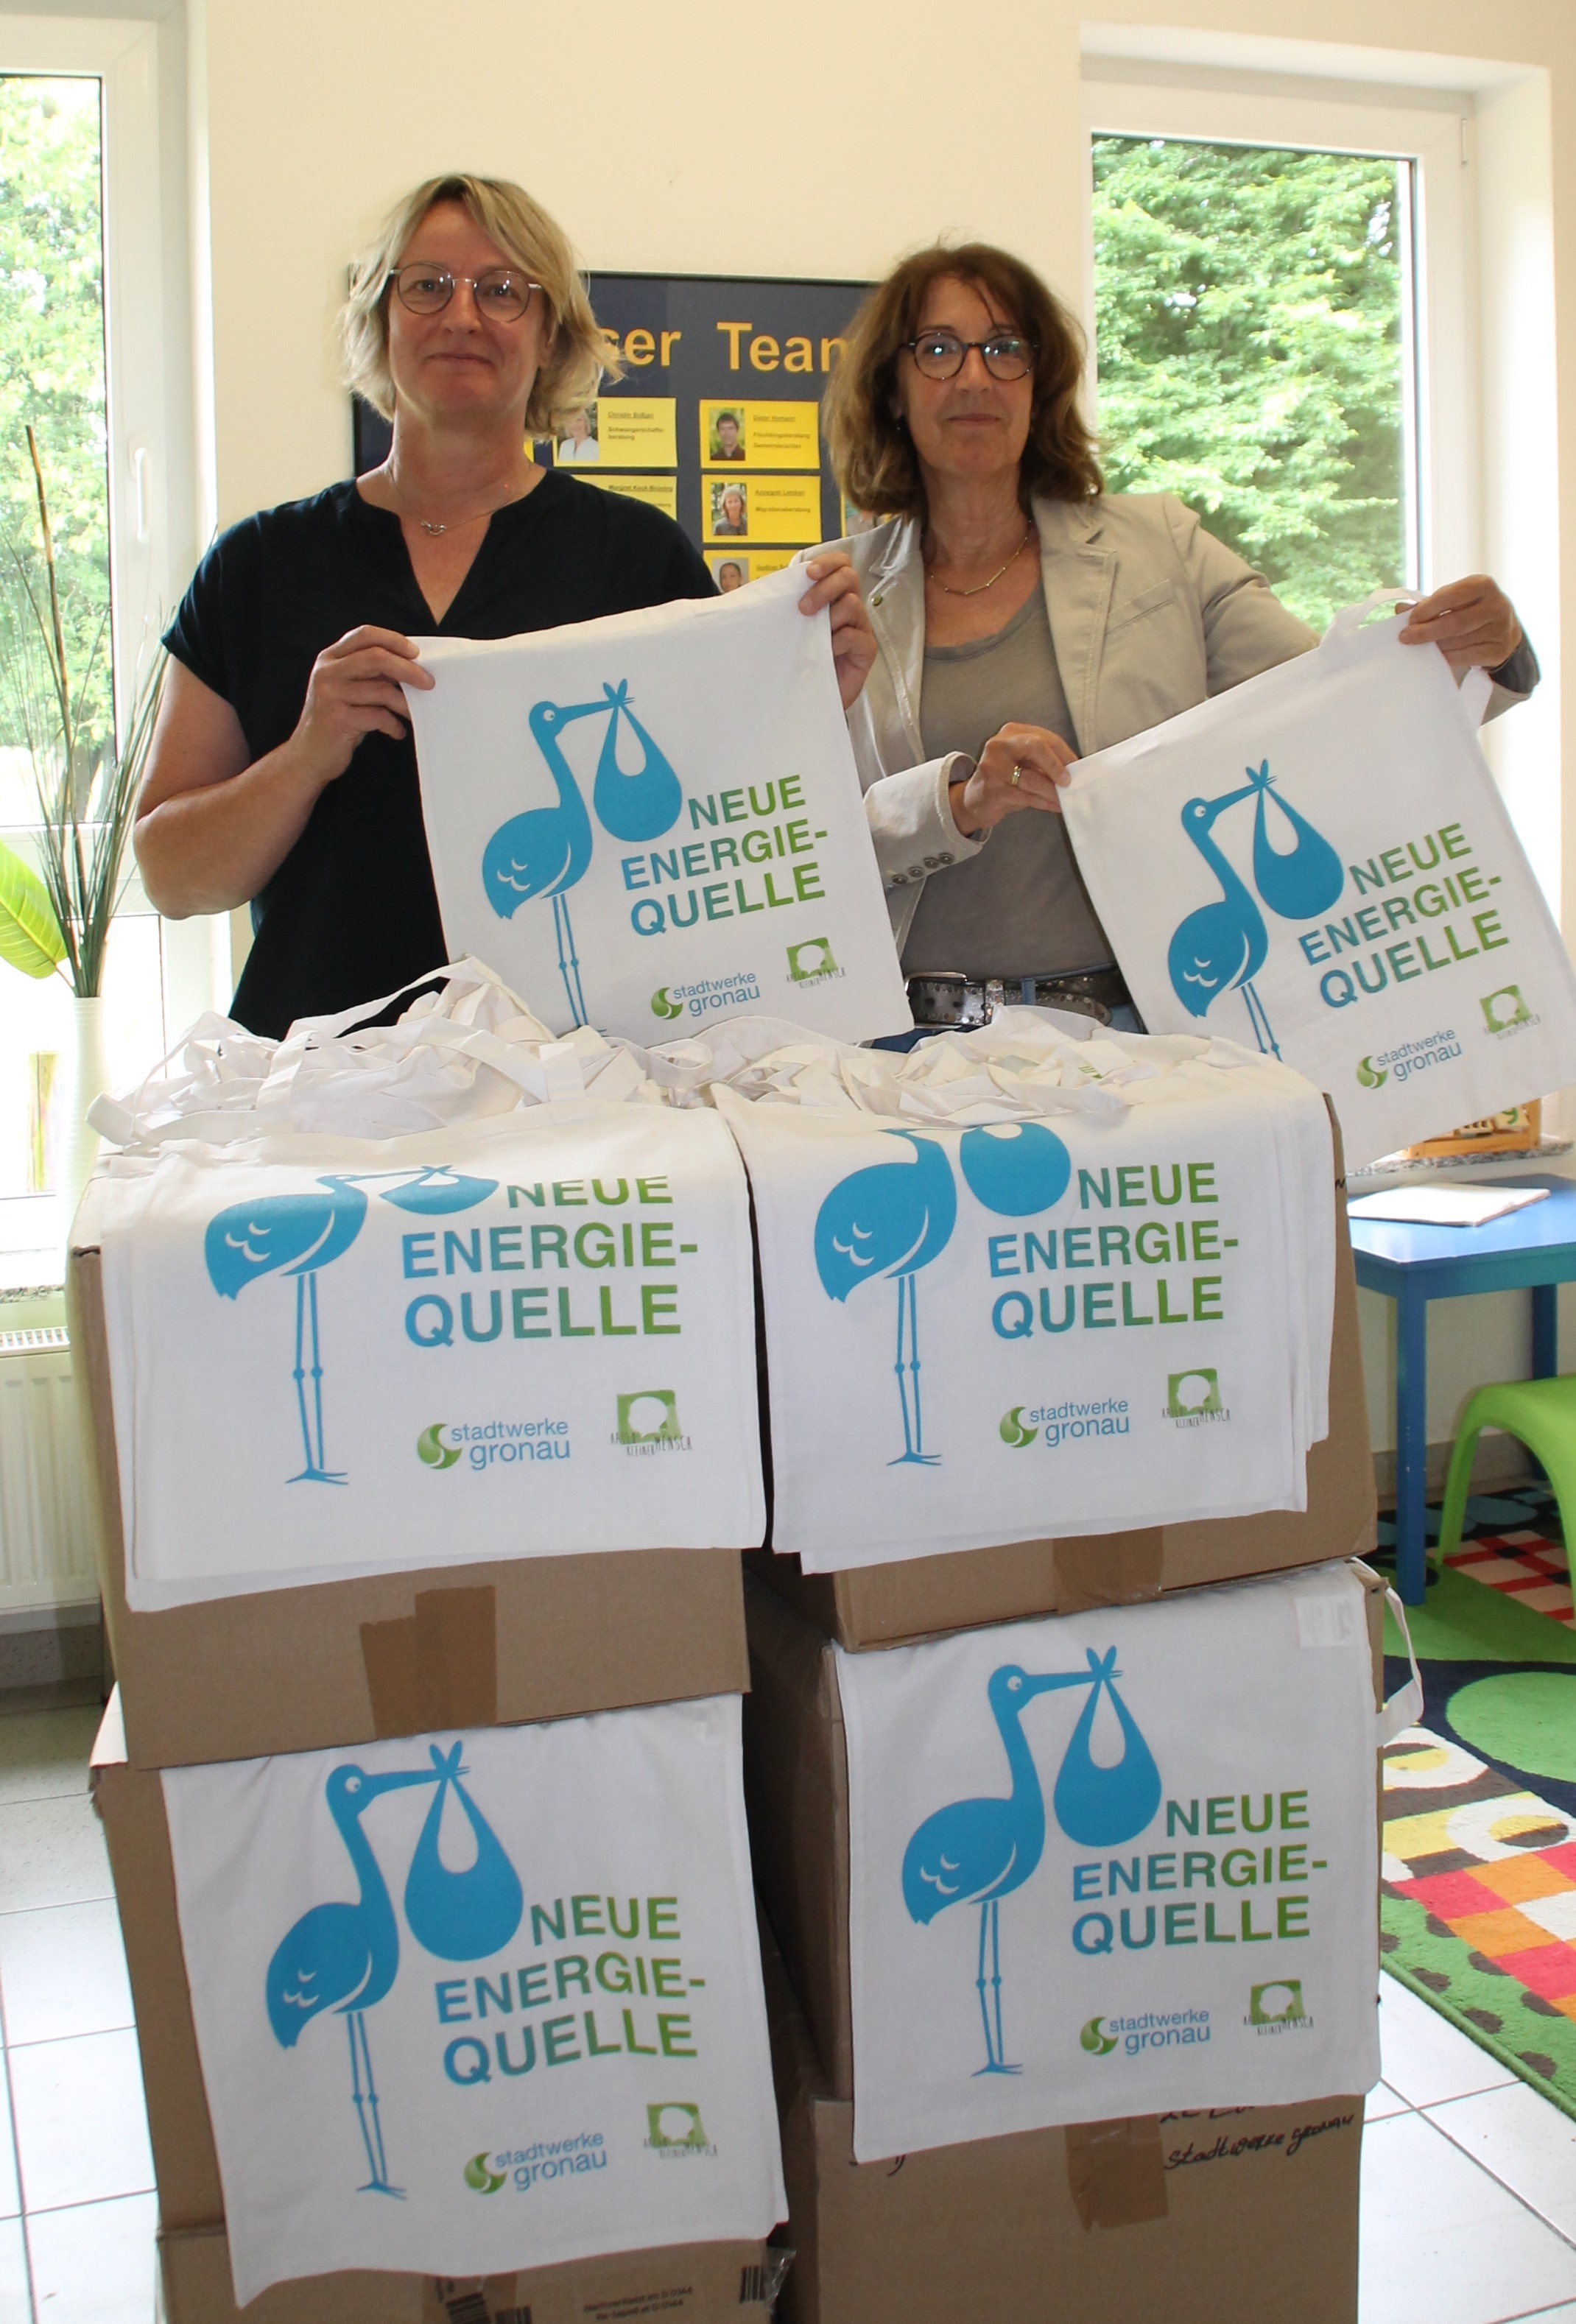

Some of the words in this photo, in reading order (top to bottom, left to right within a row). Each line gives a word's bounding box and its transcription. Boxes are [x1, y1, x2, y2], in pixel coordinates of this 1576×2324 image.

[688, 775, 805, 830] NEUE
[621, 819, 828, 890] ENERGIE-
[1349, 823, 1472, 895] NEUE
[630, 862, 825, 936] QUELLE
[1298, 866, 1502, 966] ENERGIE-
[1320, 909, 1510, 1008] QUELLE
[673, 973, 756, 999] stadtwerke
[689, 985, 760, 1017] gronau
[1377, 1029, 1455, 1066] stadtwerke
[1393, 1042, 1462, 1081] gronau
[507, 1175, 673, 1208] NEUE
[1078, 1162, 1219, 1209] NEUE
[402, 1222, 698, 1278] ENERGIE-
[988, 1219, 1239, 1278] ENERGIE-
[405, 1284, 680, 1348] QUELLE
[992, 1275, 1223, 1339] QUELLE
[451, 1418, 568, 1442] stadtwerke
[1030, 1398, 1128, 1423] stadtwerke
[1046, 1415, 1130, 1446] gronau
[469, 1440, 570, 1471] gronau
[1167, 1790, 1309, 1837] NEUE
[1073, 1844, 1327, 1901] ENERGIE-
[530, 1894, 680, 1946] NEUE
[1072, 1895, 1309, 1956] QUELLE
[435, 1951, 705, 2024] ENERGIE-
[1109, 2009, 1209, 2032] stadtwerke
[1125, 2028, 1211, 2056] gronau
[443, 2009, 697, 2085] QUELLE
[495, 2133, 604, 2168] stadtwerke
[513, 2149, 608, 2192] gronau
